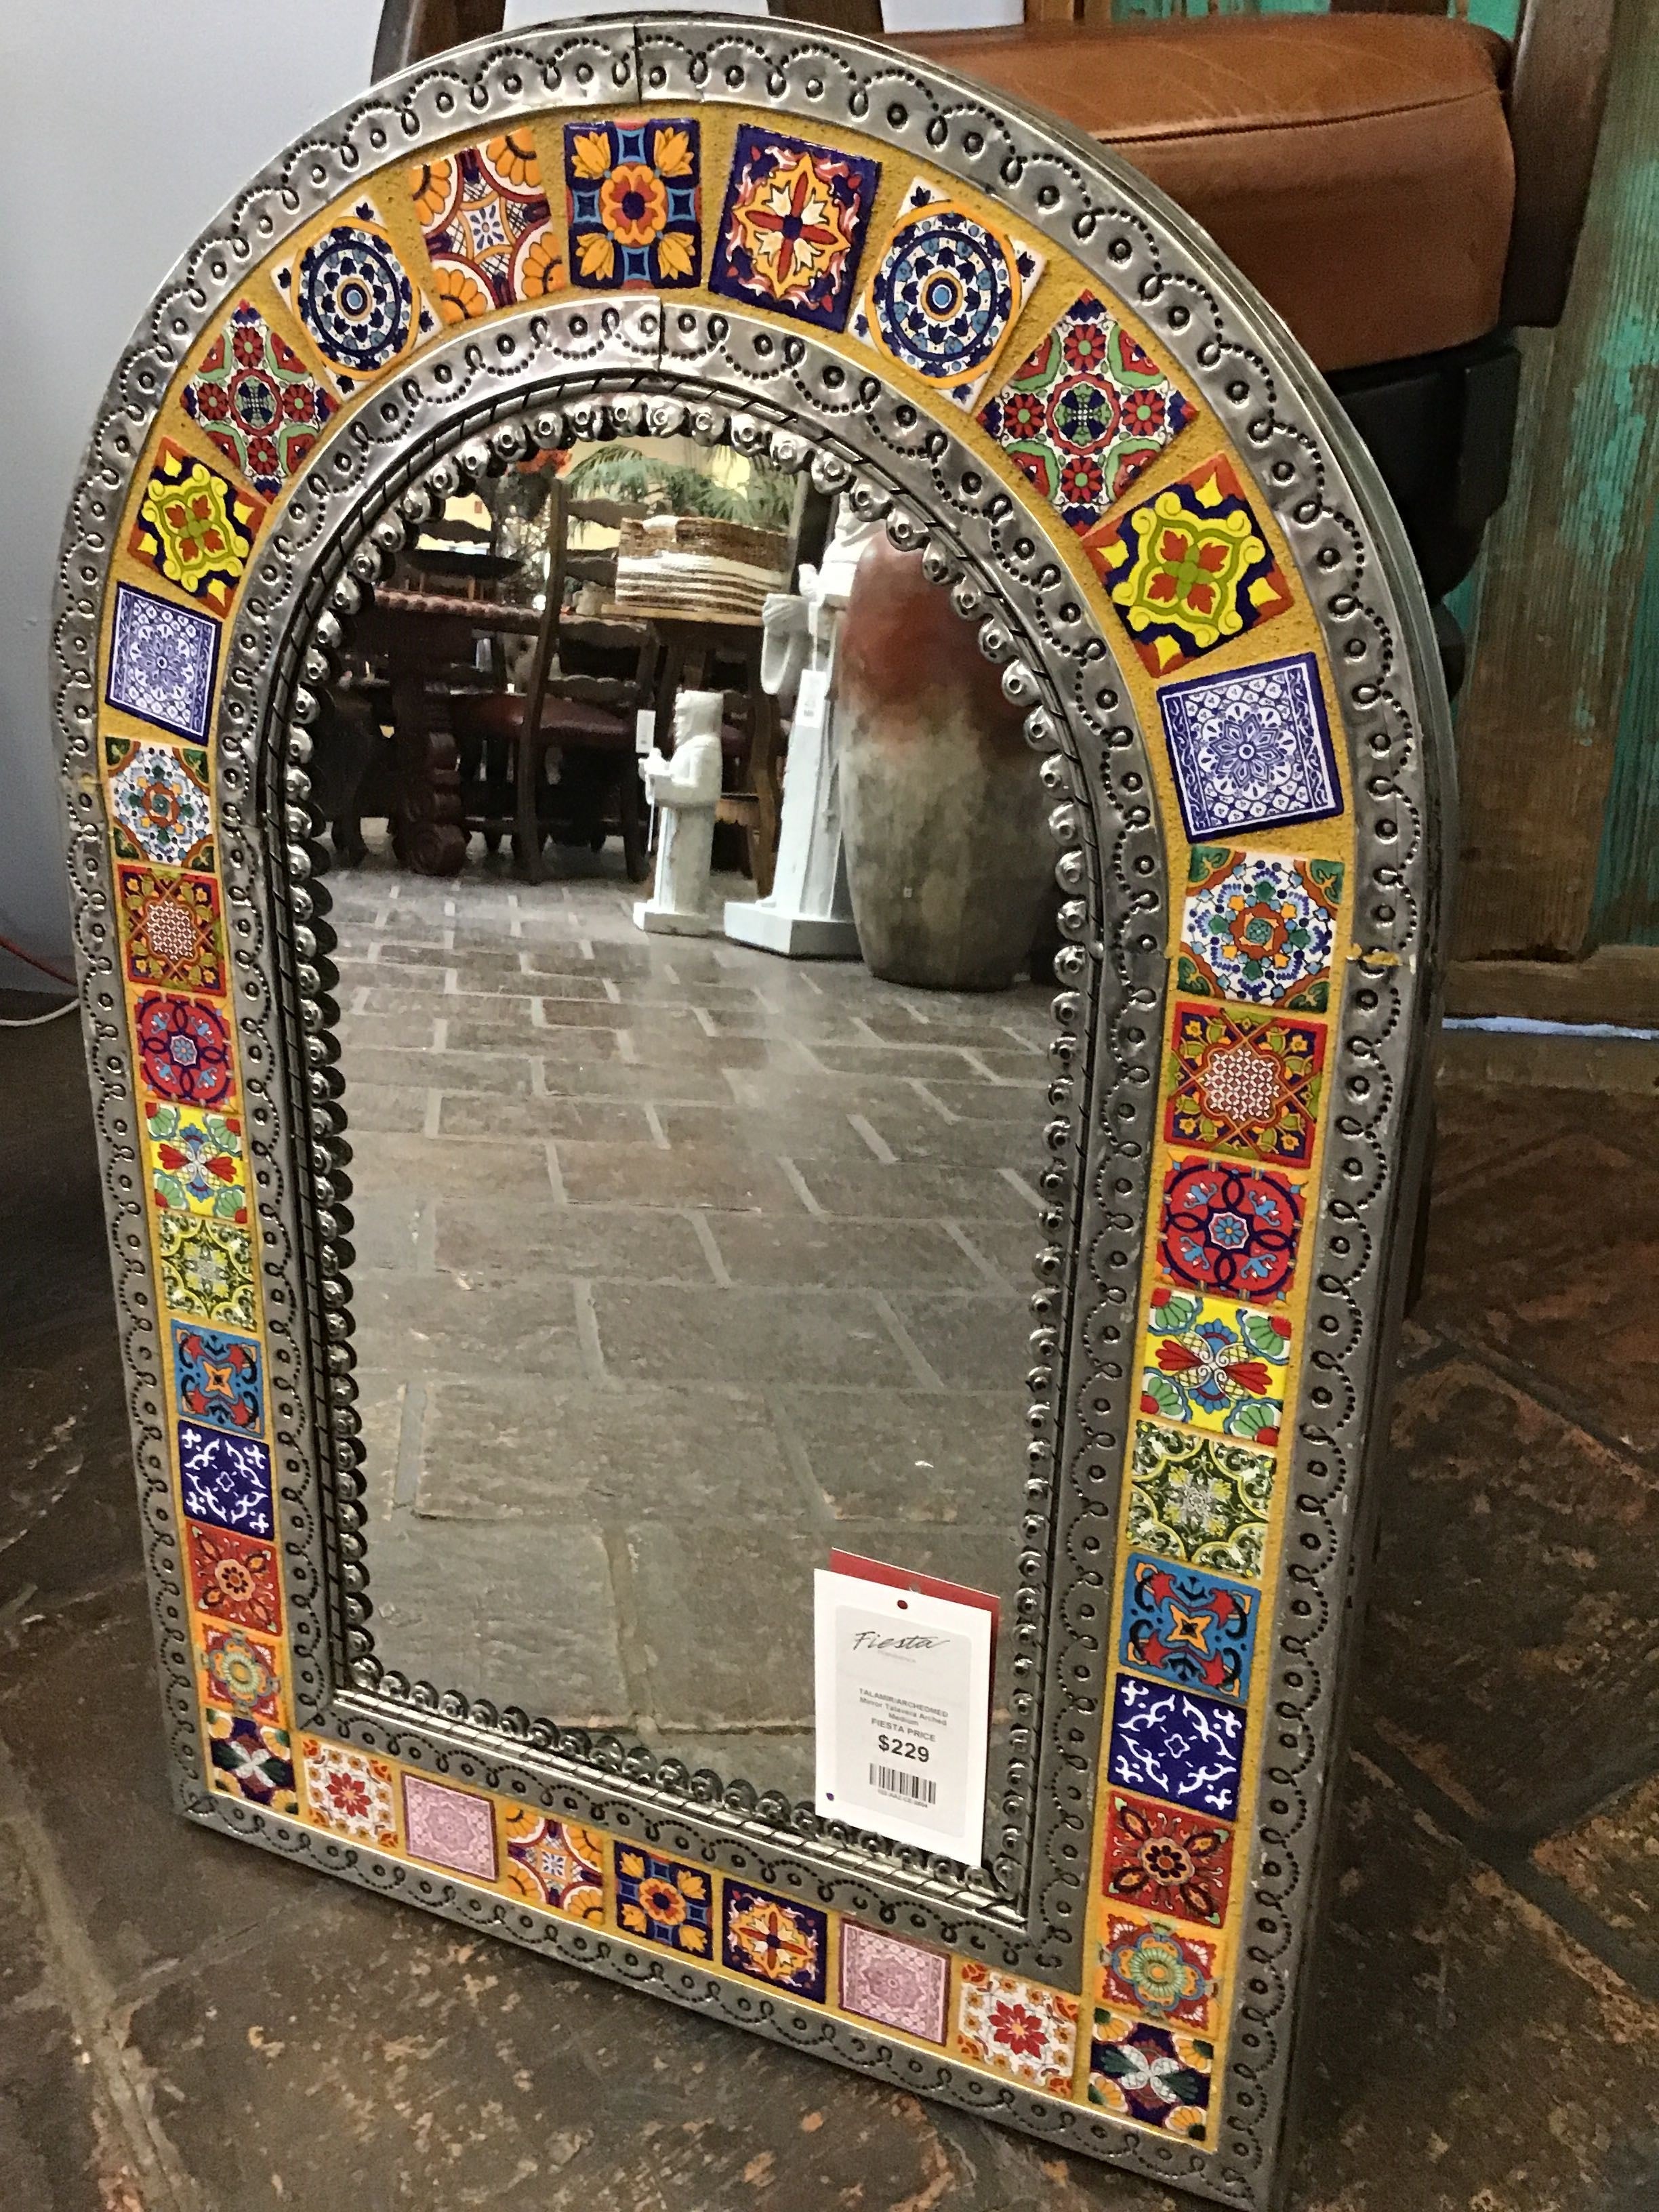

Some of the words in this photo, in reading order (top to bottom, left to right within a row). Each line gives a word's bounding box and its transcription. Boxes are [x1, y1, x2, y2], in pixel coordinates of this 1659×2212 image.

[853, 1631, 950, 1650] Fiesta
[859, 1696, 882, 1708] Mirror
[919, 1713, 947, 1726] Arched
[871, 1718, 904, 1733] FIESTA
[907, 1727, 936, 1742] PRICE
[878, 1734, 929, 1763] $229
